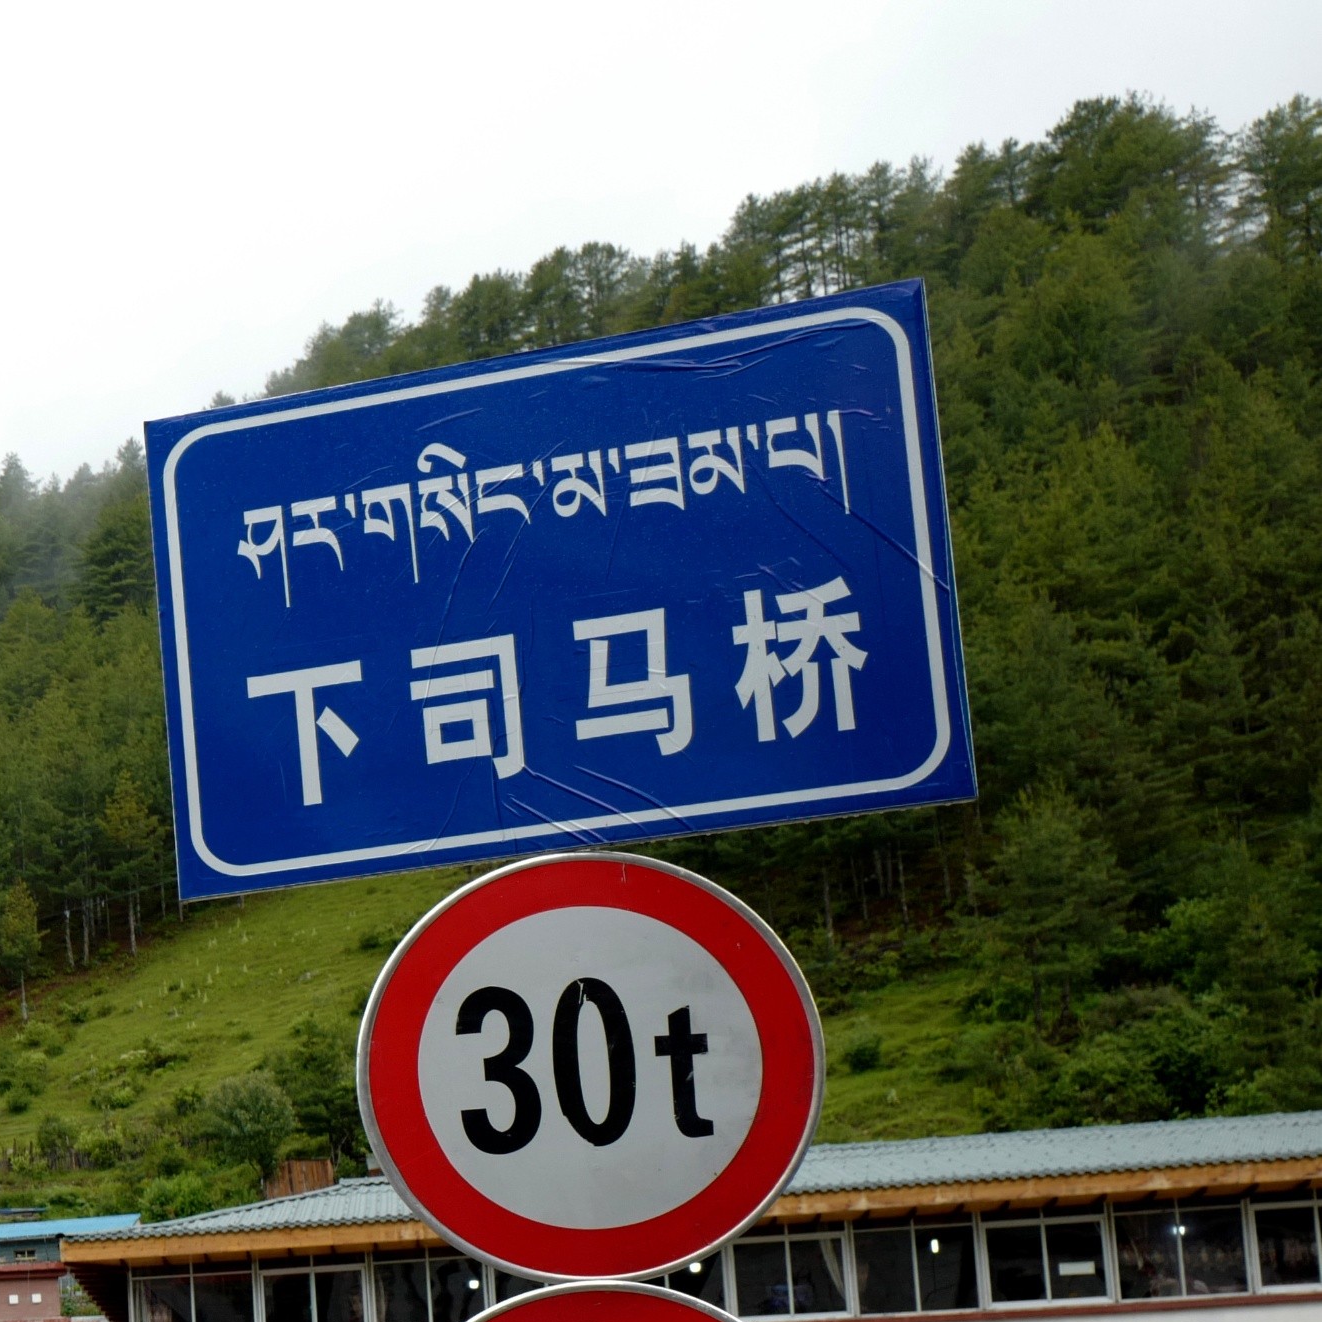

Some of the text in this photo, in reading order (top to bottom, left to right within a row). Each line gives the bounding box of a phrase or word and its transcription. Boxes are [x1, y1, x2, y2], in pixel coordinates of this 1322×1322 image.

[246, 575, 869, 806] 下司马桥
[454, 976, 715, 1156] 30t
